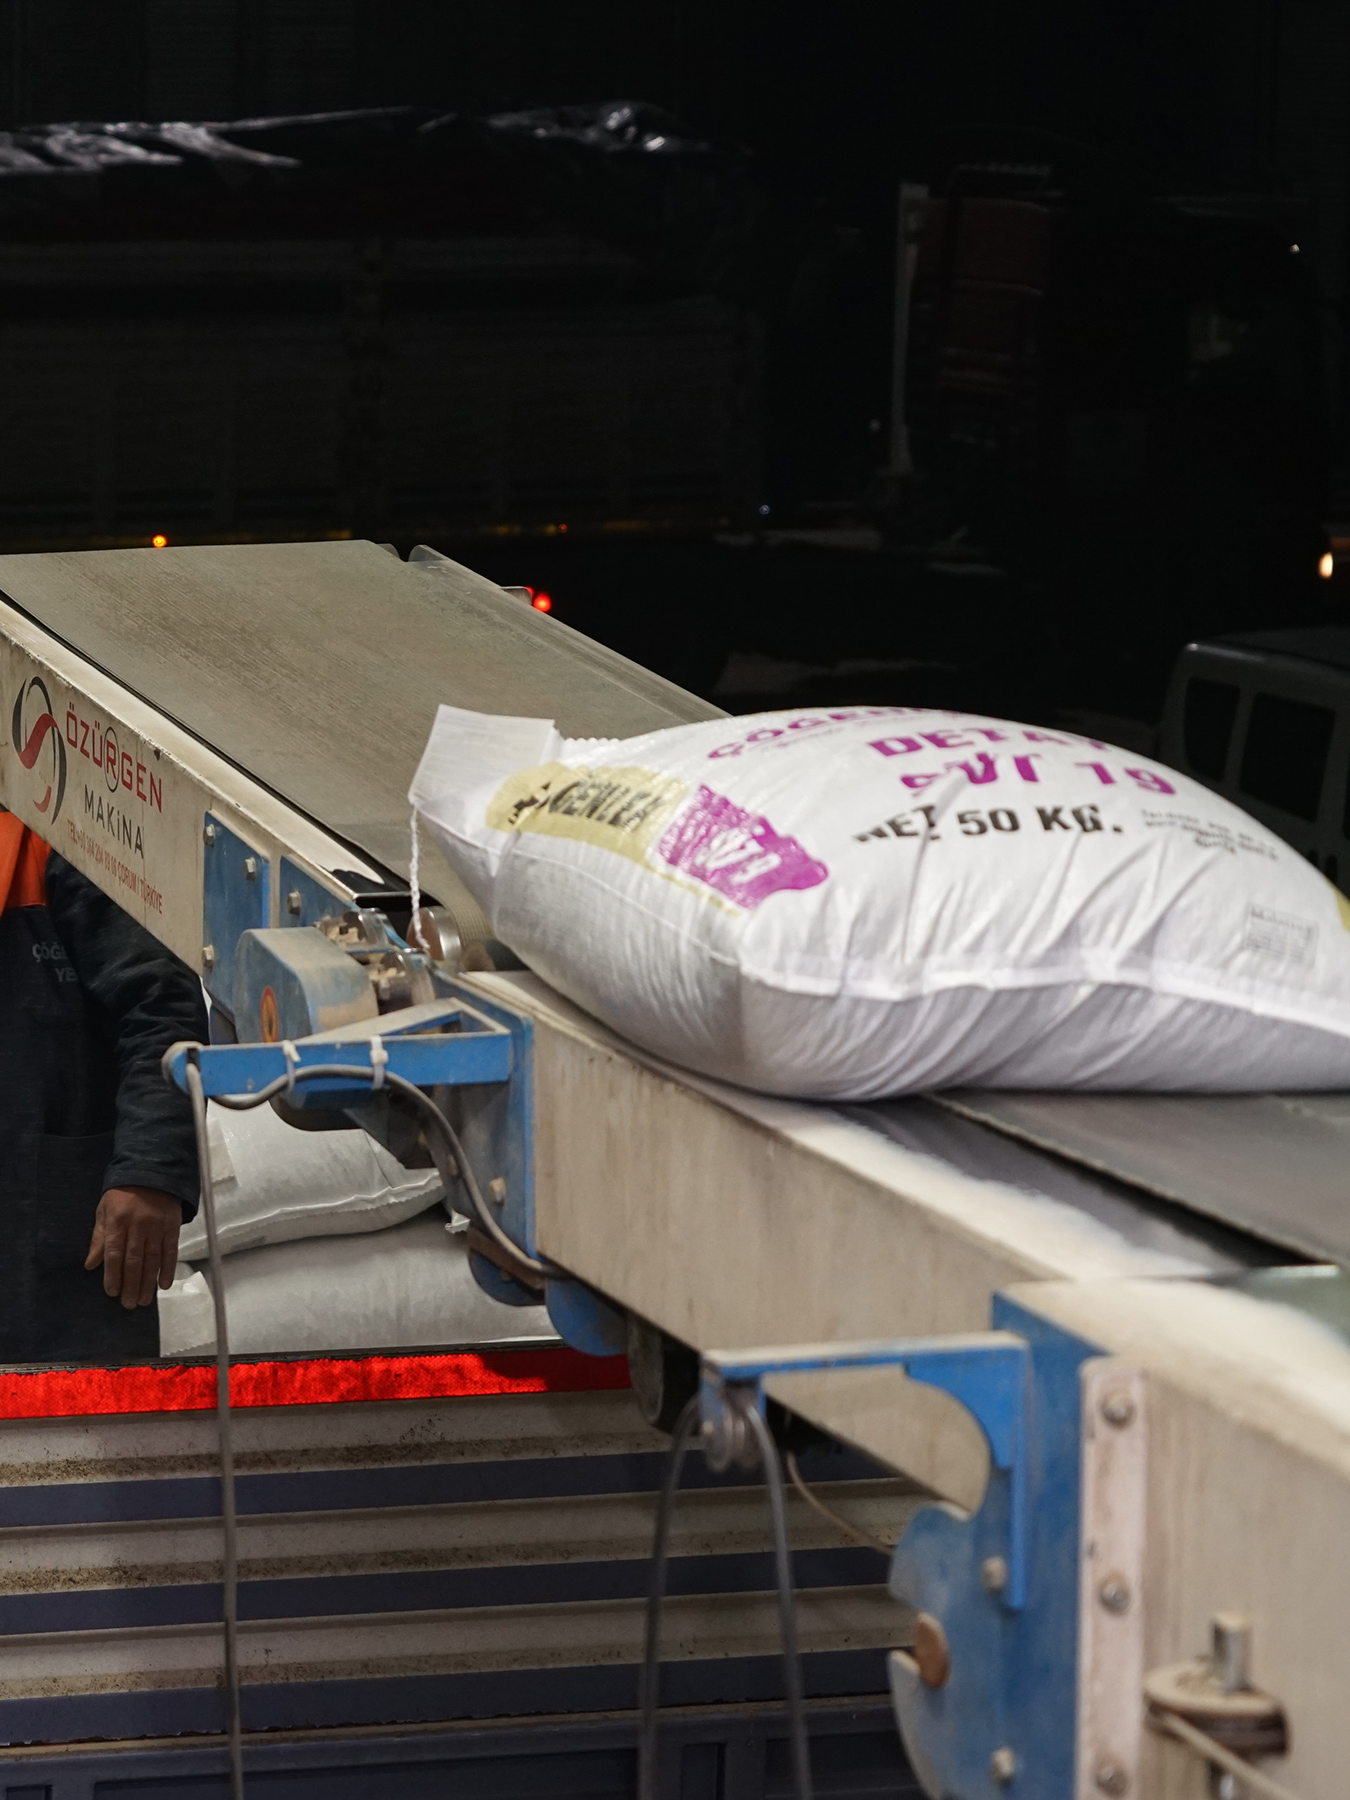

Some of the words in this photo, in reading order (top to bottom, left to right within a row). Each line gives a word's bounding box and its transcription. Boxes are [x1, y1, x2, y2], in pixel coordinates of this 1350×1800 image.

[66, 702, 162, 814] ÖZÜRGEN
[1074, 761, 1176, 795] 19
[956, 808, 1021, 836] 50
